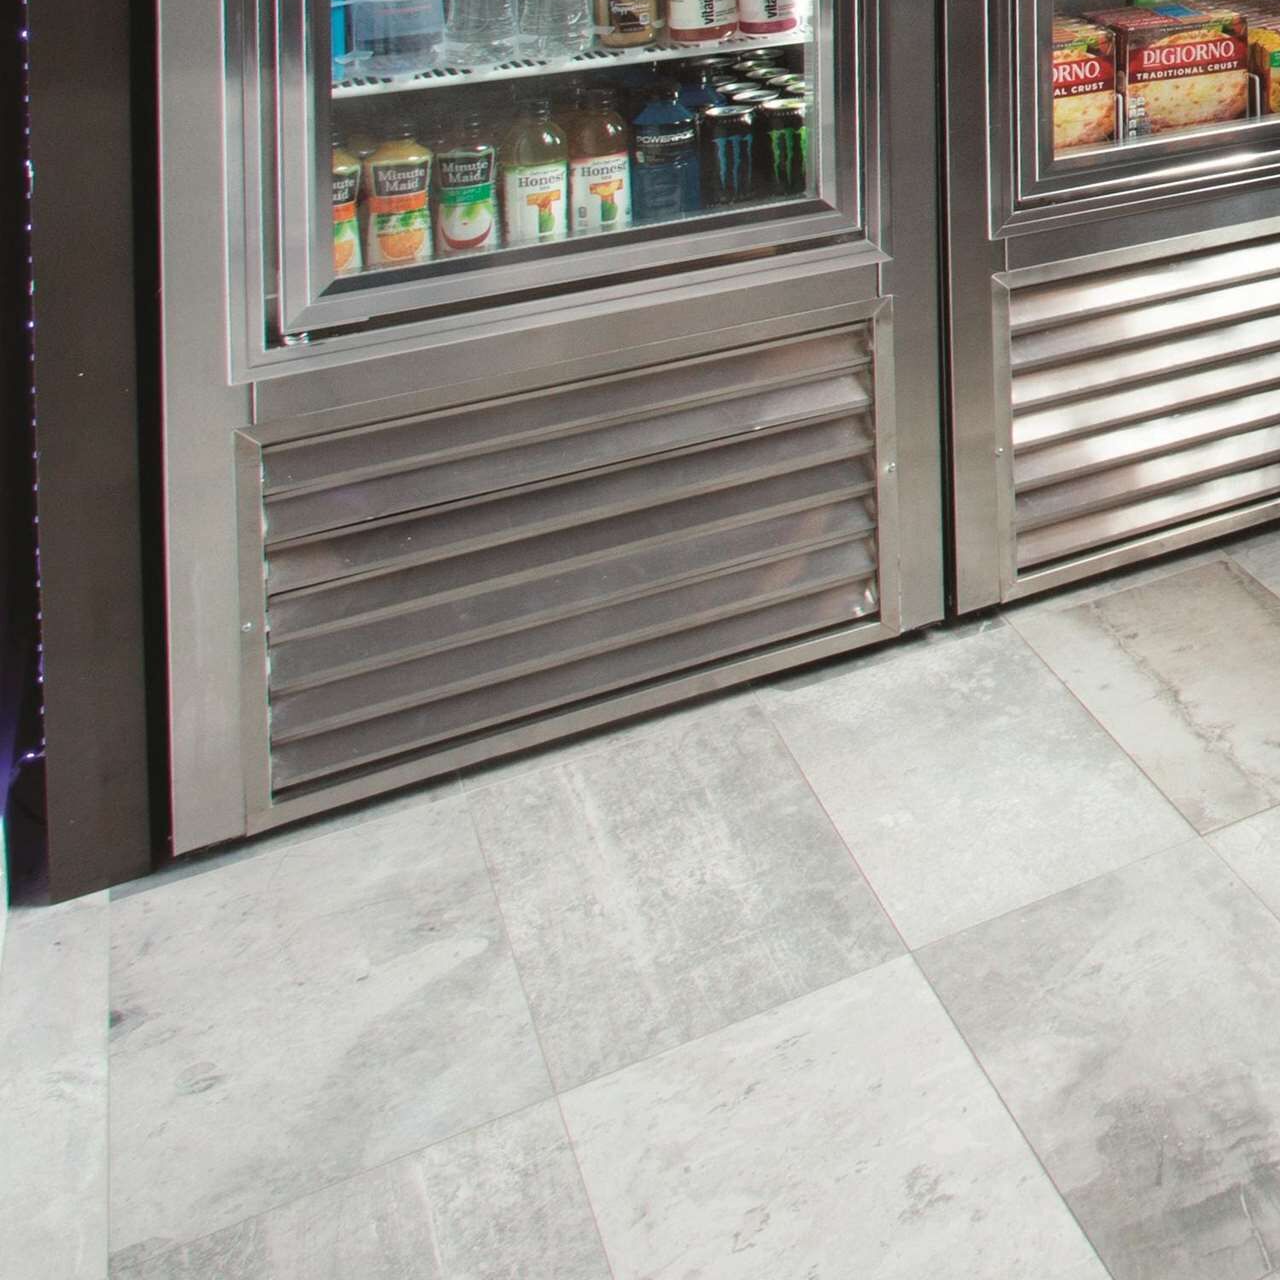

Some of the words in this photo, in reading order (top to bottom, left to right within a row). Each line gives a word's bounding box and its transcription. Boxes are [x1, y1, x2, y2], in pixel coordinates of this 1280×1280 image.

[1143, 40, 1236, 67] DIGIORNO
[1135, 66, 1205, 81] TRADITIONAL
[1207, 60, 1239, 72] CRUST
[1070, 81, 1105, 95] CRUST
[378, 167, 425, 181] Minute
[442, 160, 489, 174] Minute
[448, 170, 482, 183] Maid
[385, 177, 419, 193] Maid
